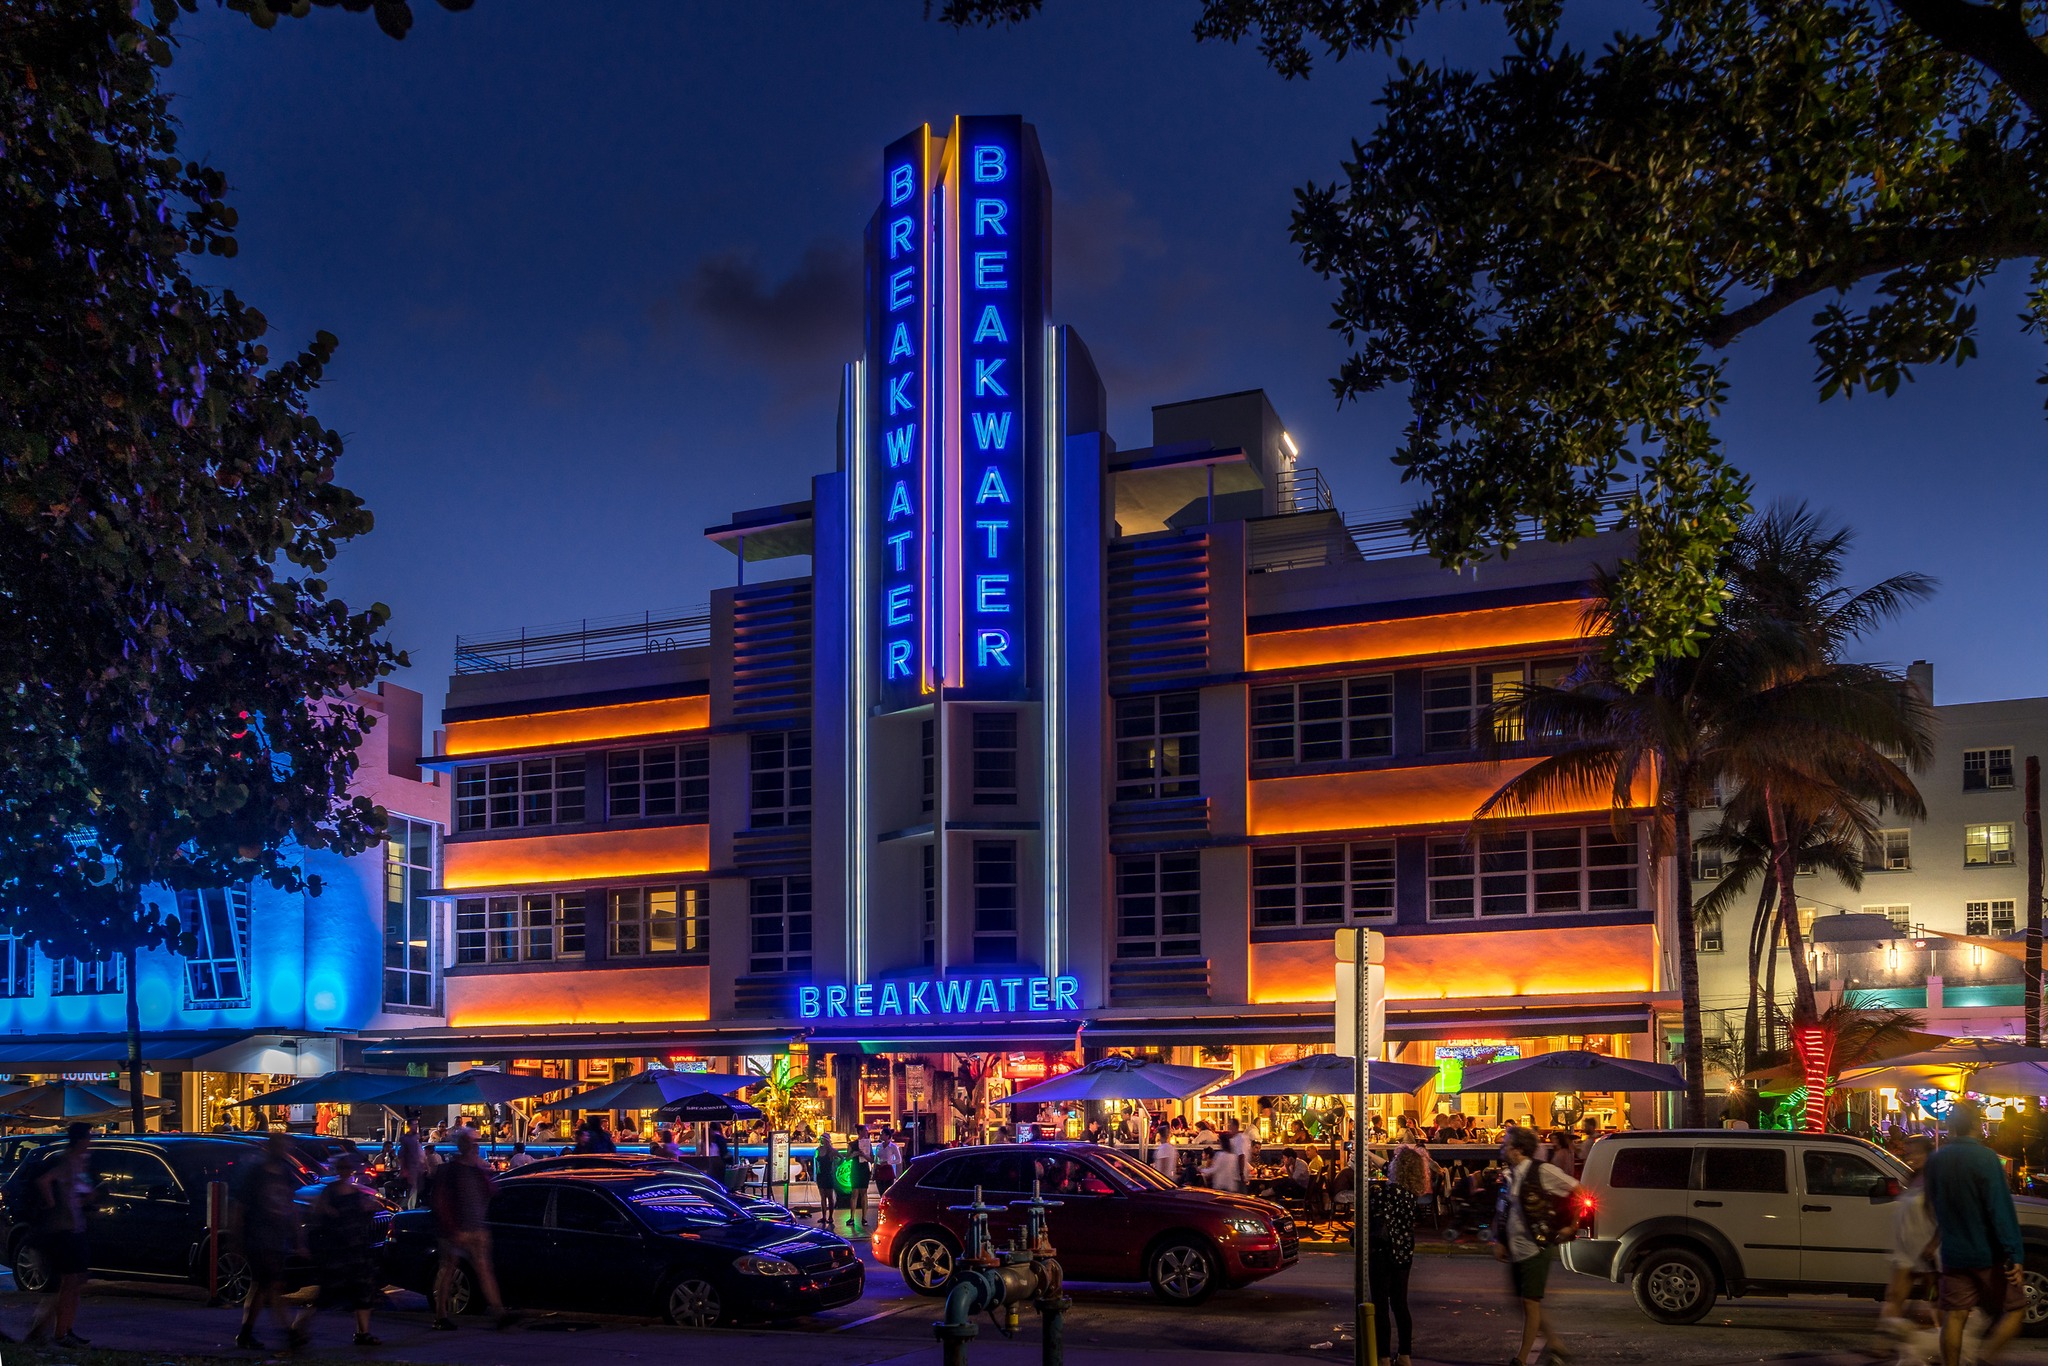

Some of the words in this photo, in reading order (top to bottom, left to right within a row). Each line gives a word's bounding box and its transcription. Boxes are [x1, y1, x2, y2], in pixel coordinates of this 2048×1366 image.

[886, 163, 916, 680] BREAKWATER
[972, 145, 1012, 667] BREAKWATER
[799, 975, 1079, 1018] BREAKWATER
